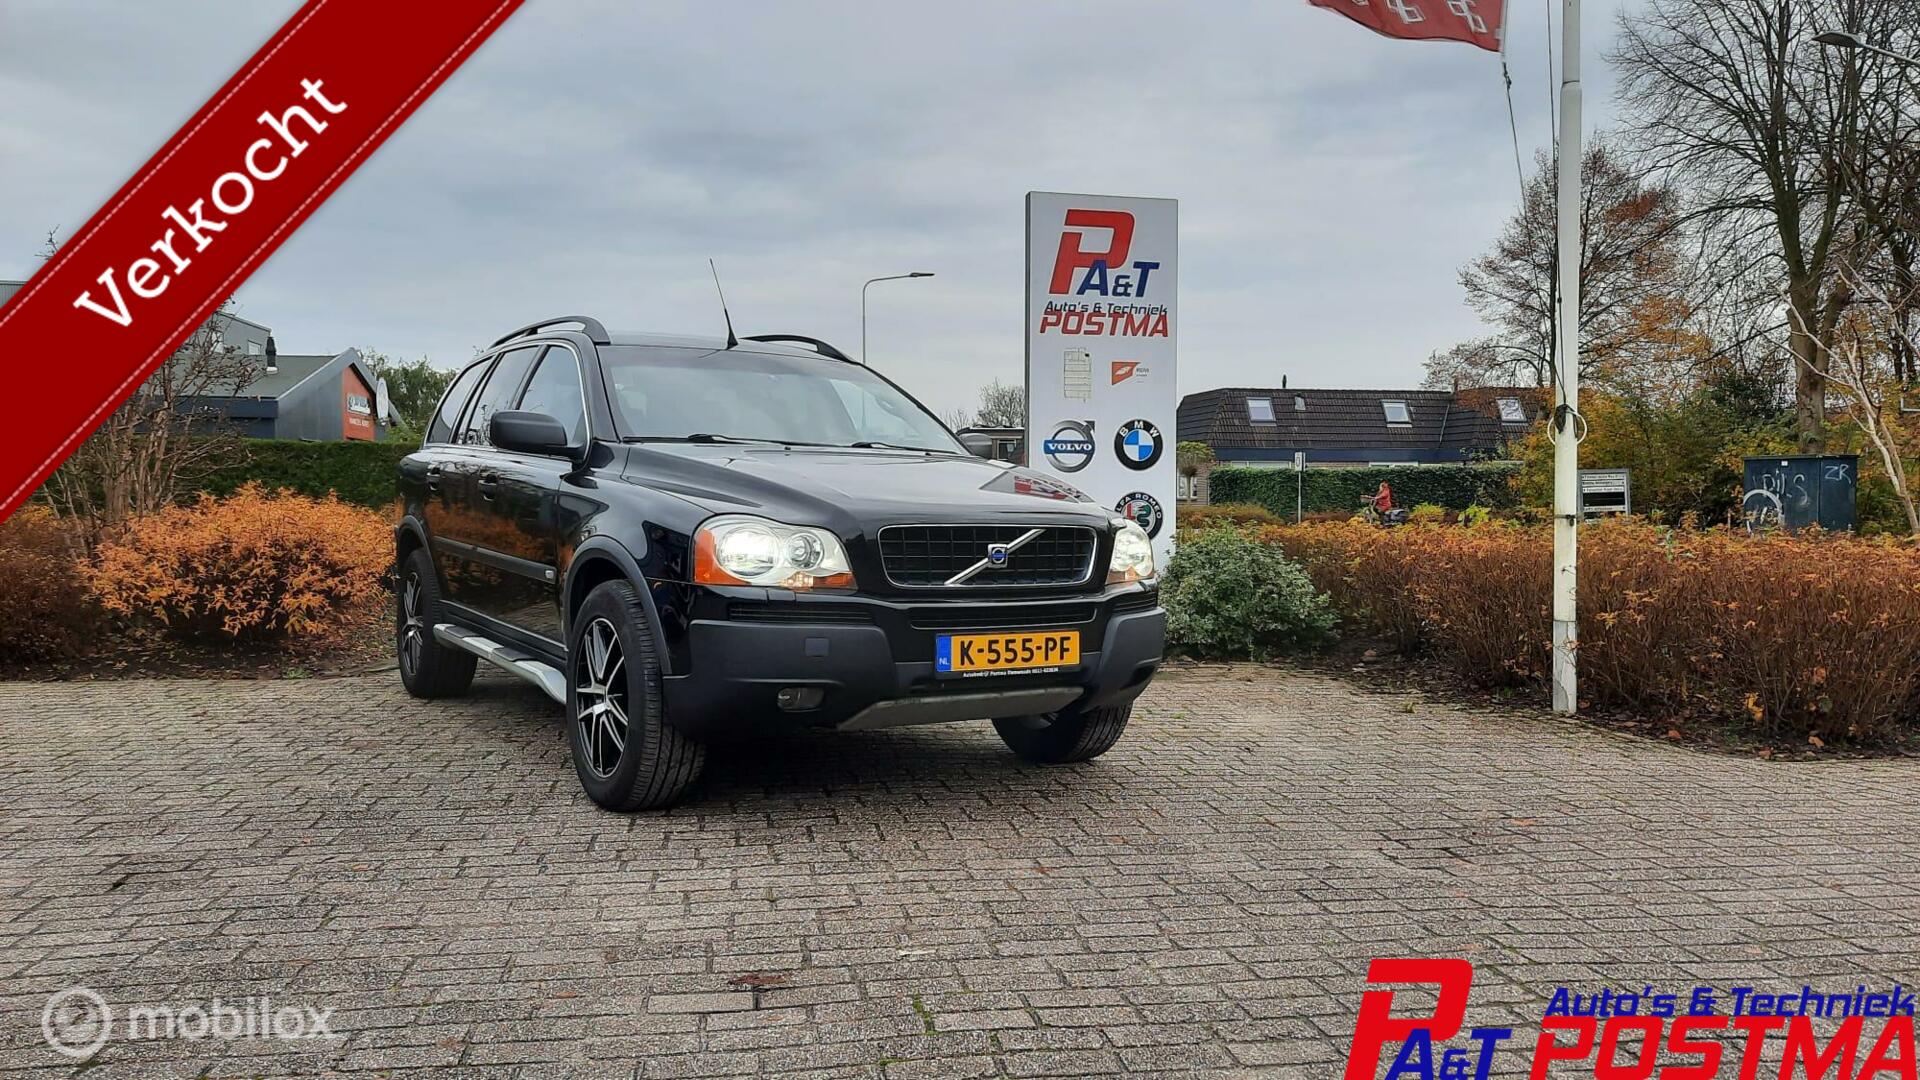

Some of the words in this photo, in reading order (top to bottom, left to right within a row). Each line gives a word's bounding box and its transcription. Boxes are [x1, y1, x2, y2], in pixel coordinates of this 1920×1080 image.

[1044, 301, 1089, 313] Auto's
[1093, 302, 1103, 313] &
[1107, 303, 1168, 316] Techniek
[1040, 311, 1169, 337] POSTMA
[1119, 420, 1160, 437] BMW
[1047, 442, 1093, 451] VOLVO
[1135, 493, 1162, 519] ROMEO
[960, 636, 1071, 666] K-555-PF
[938, 657, 950, 666] NL
